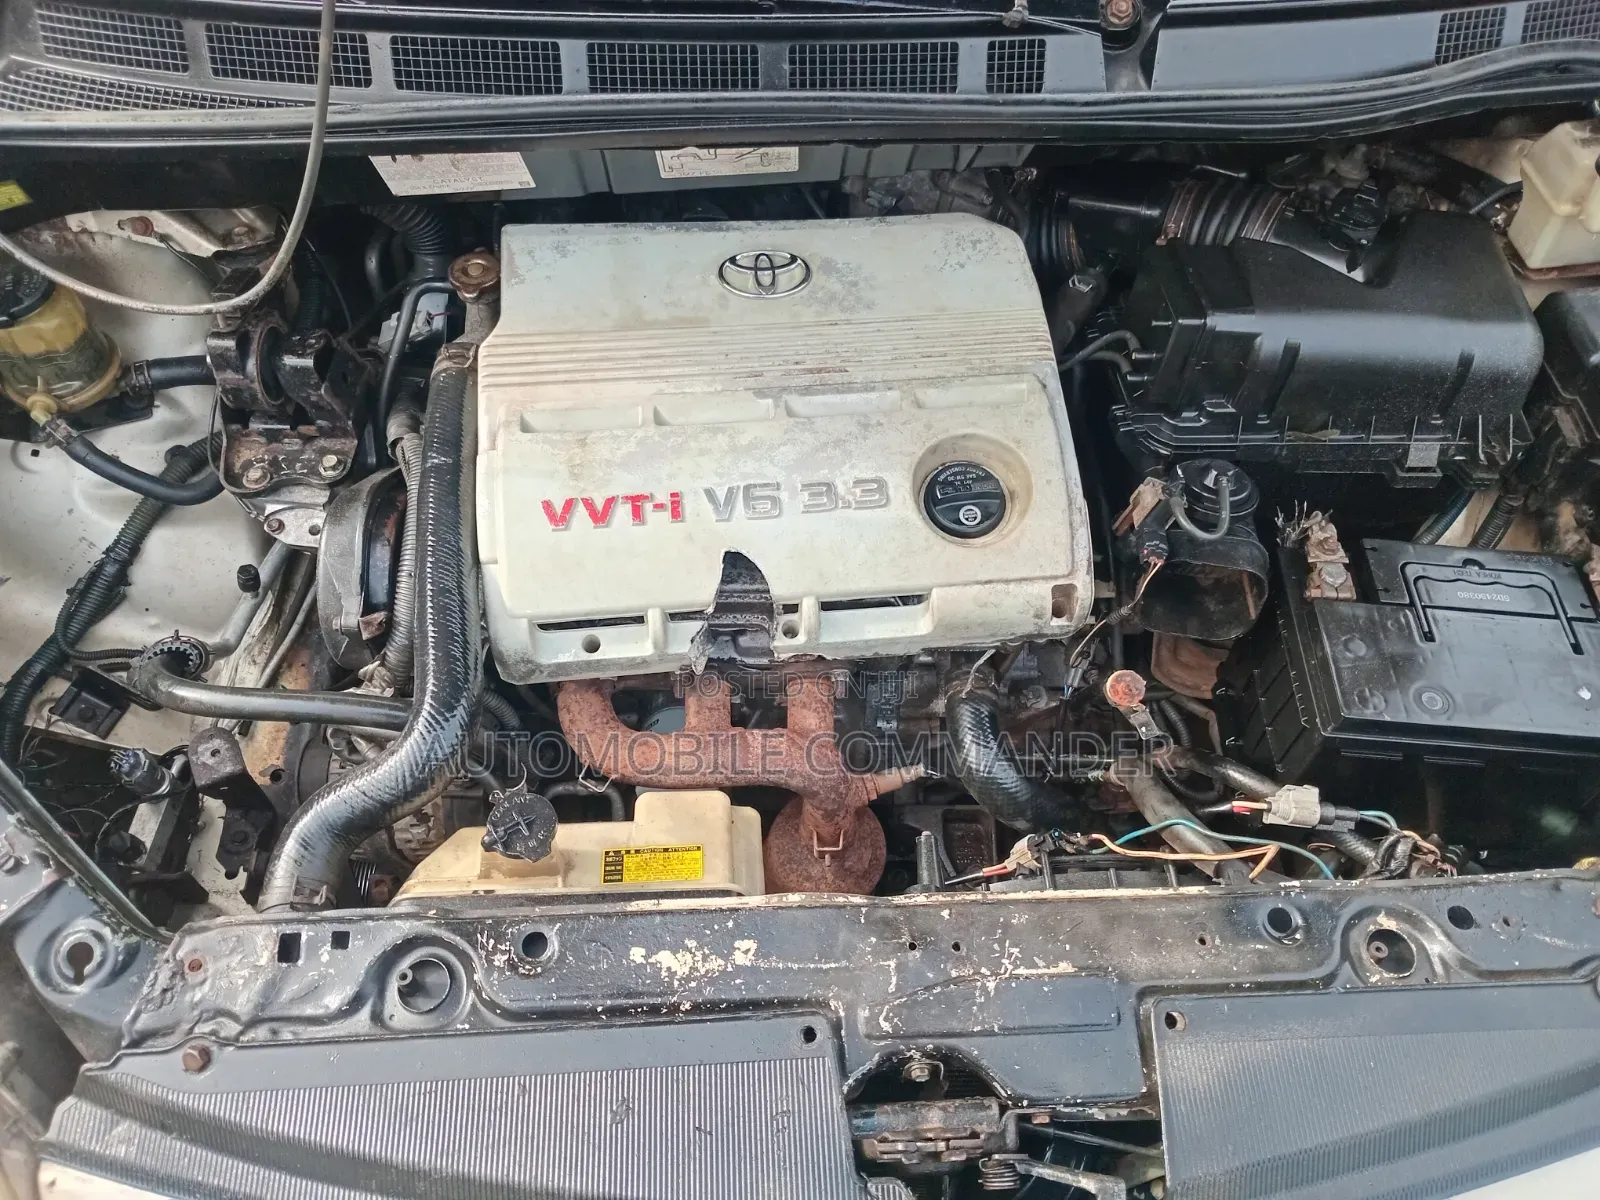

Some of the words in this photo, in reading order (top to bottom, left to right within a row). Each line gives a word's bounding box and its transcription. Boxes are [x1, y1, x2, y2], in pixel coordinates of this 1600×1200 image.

[432, 175, 483, 184] CATALYST
[937, 466, 966, 482] CONSERVING
[541, 491, 684, 532] VVT-i
[702, 481, 781, 522] V6
[799, 476, 889, 513] 3.3
